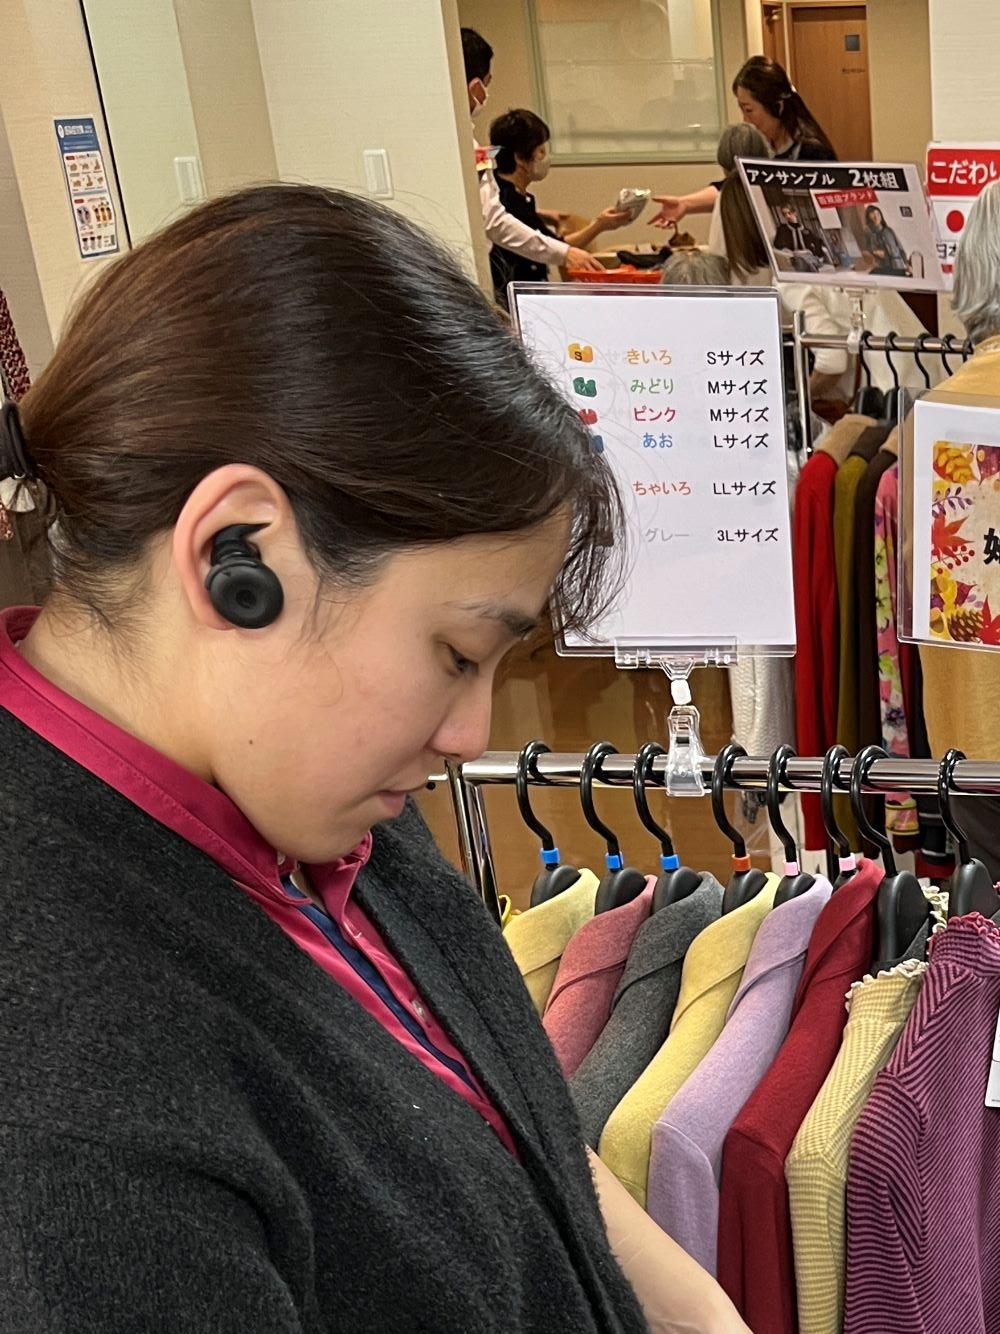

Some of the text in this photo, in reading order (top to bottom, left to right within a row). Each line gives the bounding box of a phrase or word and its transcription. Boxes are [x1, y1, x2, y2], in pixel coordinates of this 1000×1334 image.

[746, 168, 900, 189] アンサンブル 2枚組
[627, 348, 672, 365] きいろ
[707, 350, 765, 366] Sサイズ
[630, 379, 674, 395] みどり
[708, 379, 768, 395] Mサイズ
[633, 407, 769, 423] ピンク Mサイズ
[642, 432, 769, 448] あお Lサイズ
[633, 480, 777, 496] ちゃいろ LLサイズ
[645, 528, 779, 543] グレー 3Lサイズ
